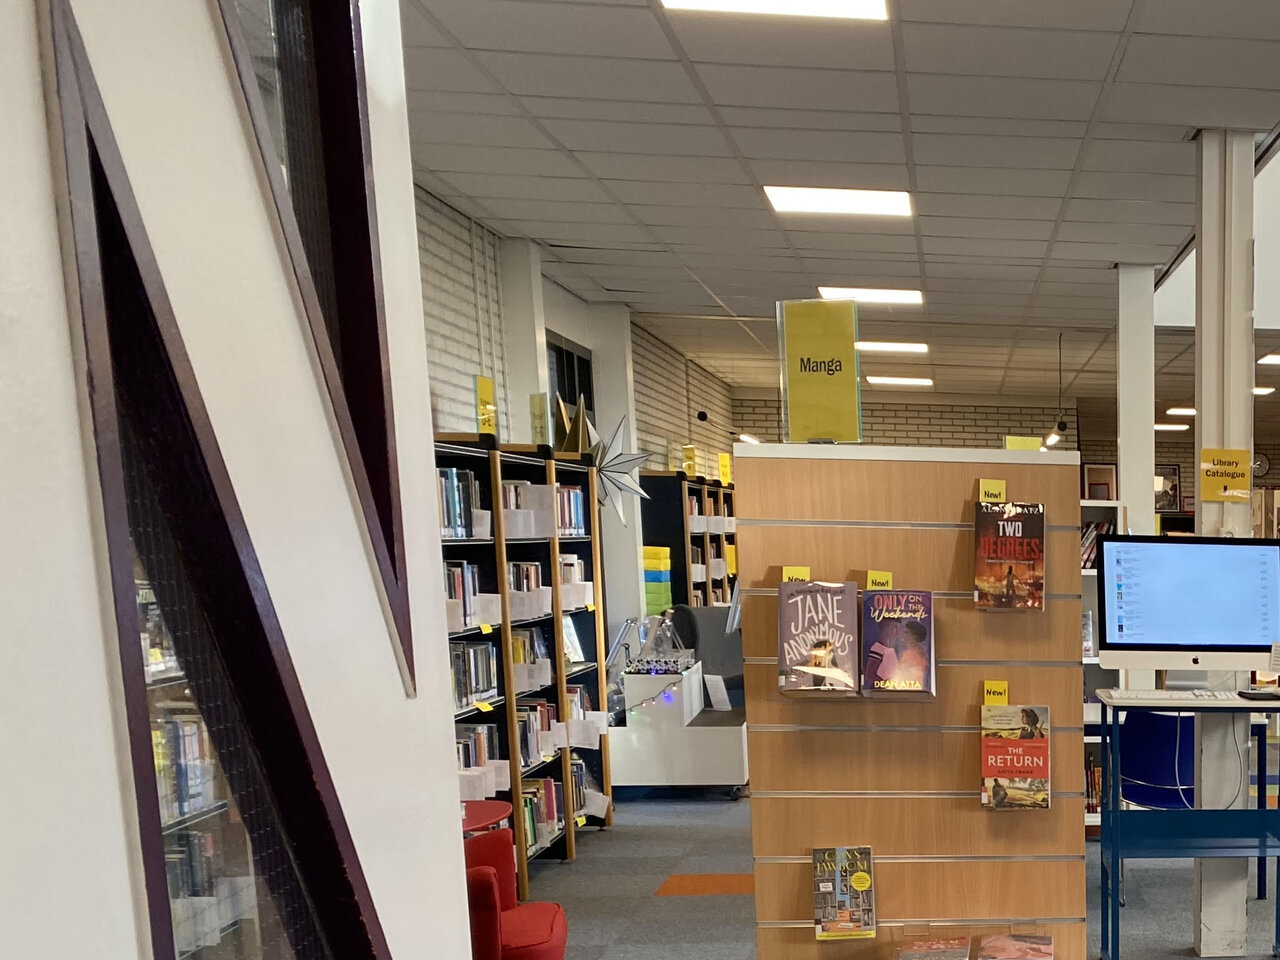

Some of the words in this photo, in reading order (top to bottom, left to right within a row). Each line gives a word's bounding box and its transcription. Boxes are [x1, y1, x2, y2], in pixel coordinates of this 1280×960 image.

[800, 357, 842, 376] Manga
[1212, 458, 1240, 469] Library
[1205, 469, 1246, 480] Catalogue
[984, 490, 1002, 500] New!
[997, 521, 1023, 537] TWO
[980, 536, 1040, 560] DEGREES
[871, 579, 889, 588] New!
[873, 594, 908, 610] ONLY
[908, 603, 923, 611] THE
[788, 593, 845, 635] JANE
[870, 605, 929, 623] Weekends
[783, 621, 854, 665] ANONYMOUS
[873, 680, 898, 689] DEAN
[900, 680, 921, 689] ATTA
[985, 688, 1007, 697] New!
[1007, 747, 1024, 755] THE
[987, 755, 1044, 767] RETURN
